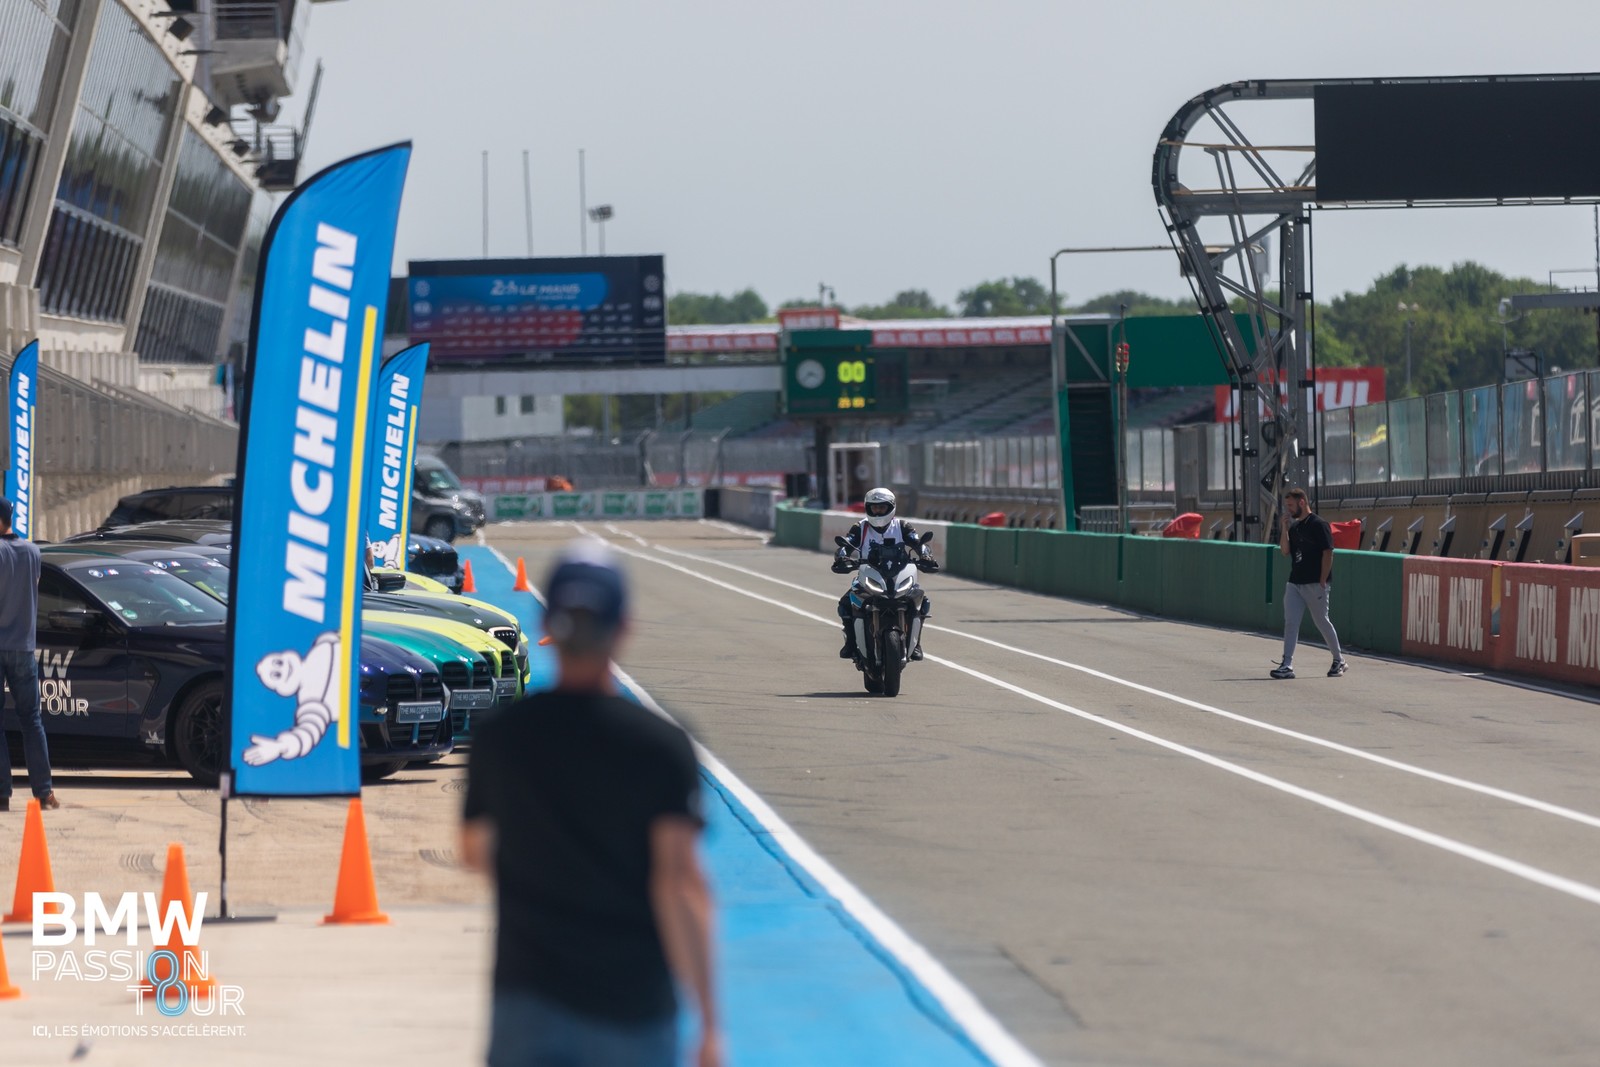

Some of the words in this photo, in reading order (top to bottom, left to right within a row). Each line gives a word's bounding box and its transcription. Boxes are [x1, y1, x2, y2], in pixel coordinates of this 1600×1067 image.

[15, 372, 30, 534] MICHELIN
[282, 222, 358, 623] MICHELIN
[378, 373, 410, 530] MICHELIN
[1406, 573, 1440, 645] MOTUL
[1447, 576, 1483, 651] MOTUL
[1515, 582, 1557, 663] MOTUL
[1567, 587, 1600, 672] MOT
[400, 705, 409, 715] THE
[416, 705, 441, 714] COMPETITION
